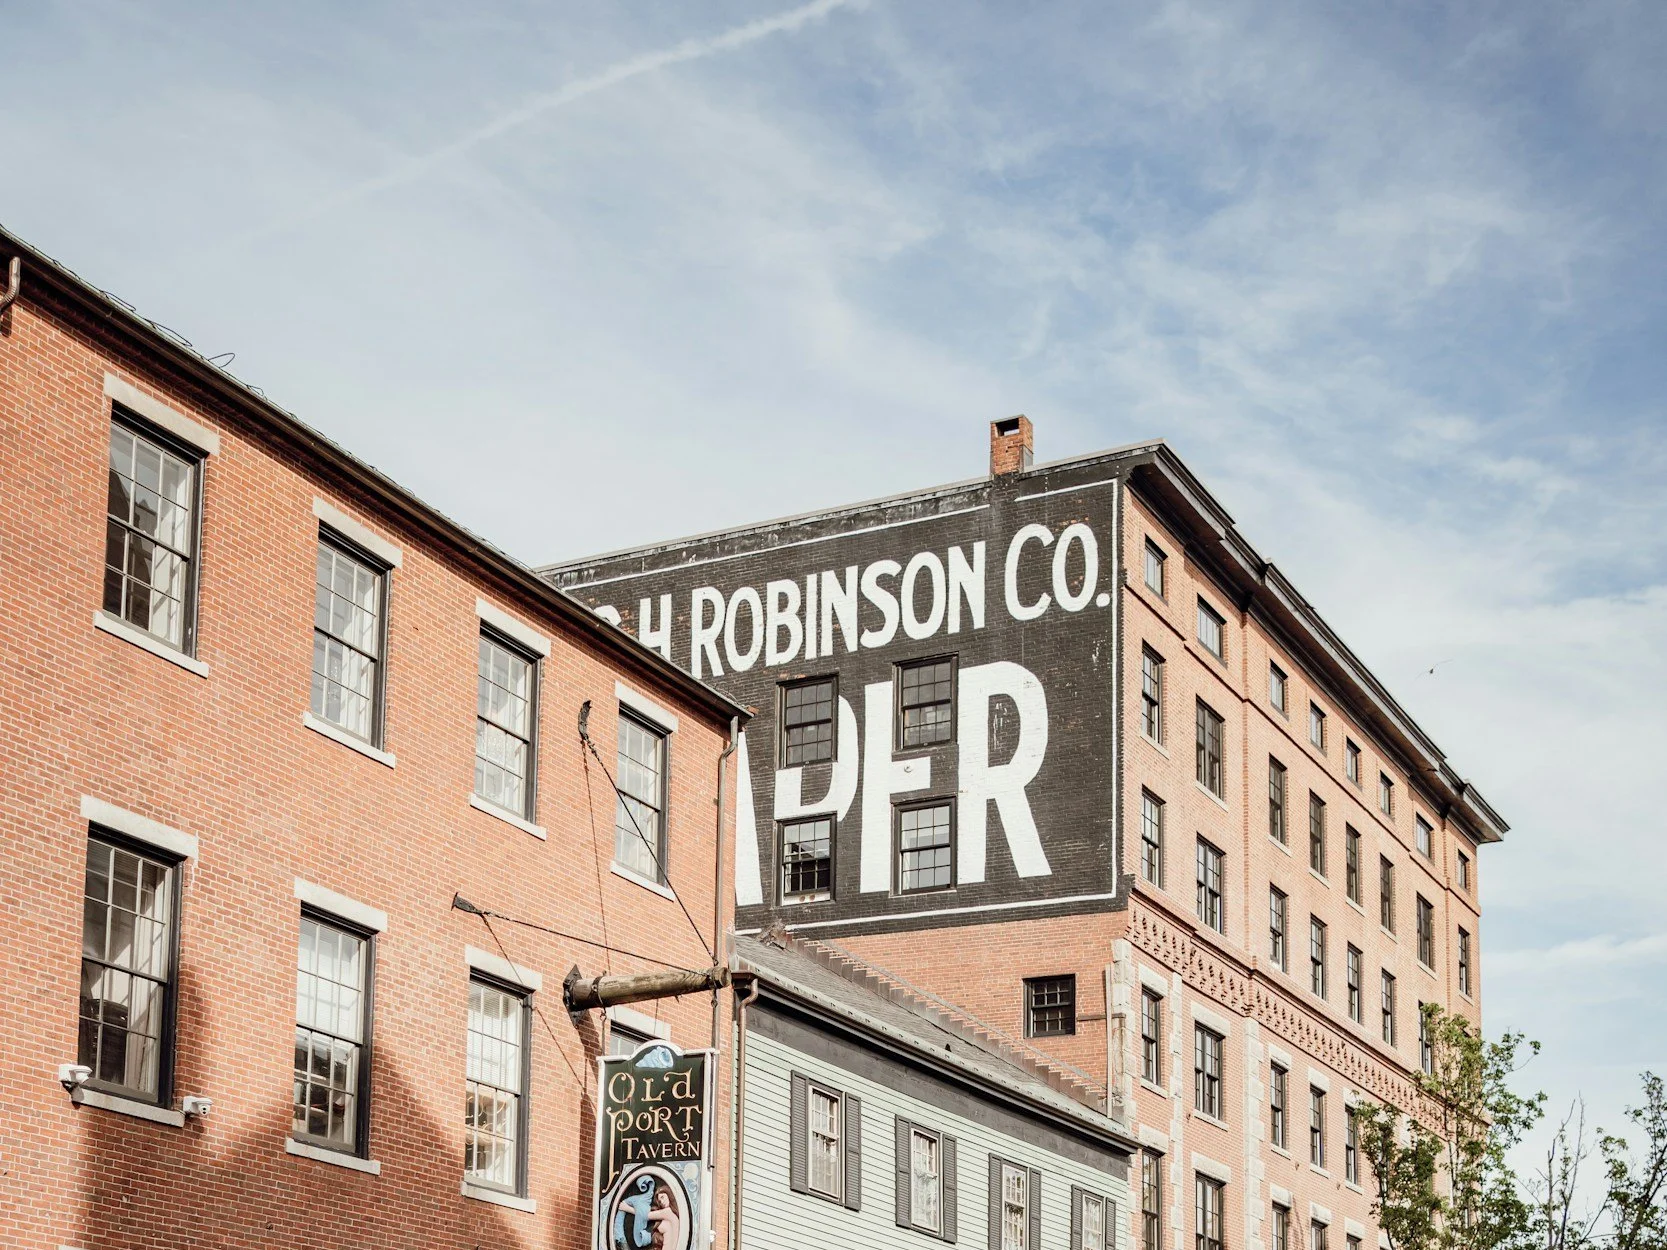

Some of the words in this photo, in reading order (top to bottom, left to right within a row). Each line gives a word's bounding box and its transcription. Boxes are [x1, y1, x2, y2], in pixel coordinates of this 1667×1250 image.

[691, 541, 986, 680] ROBINSON
[1004, 523, 1111, 621] CO.
[621, 1137, 701, 1159] TAVERN
